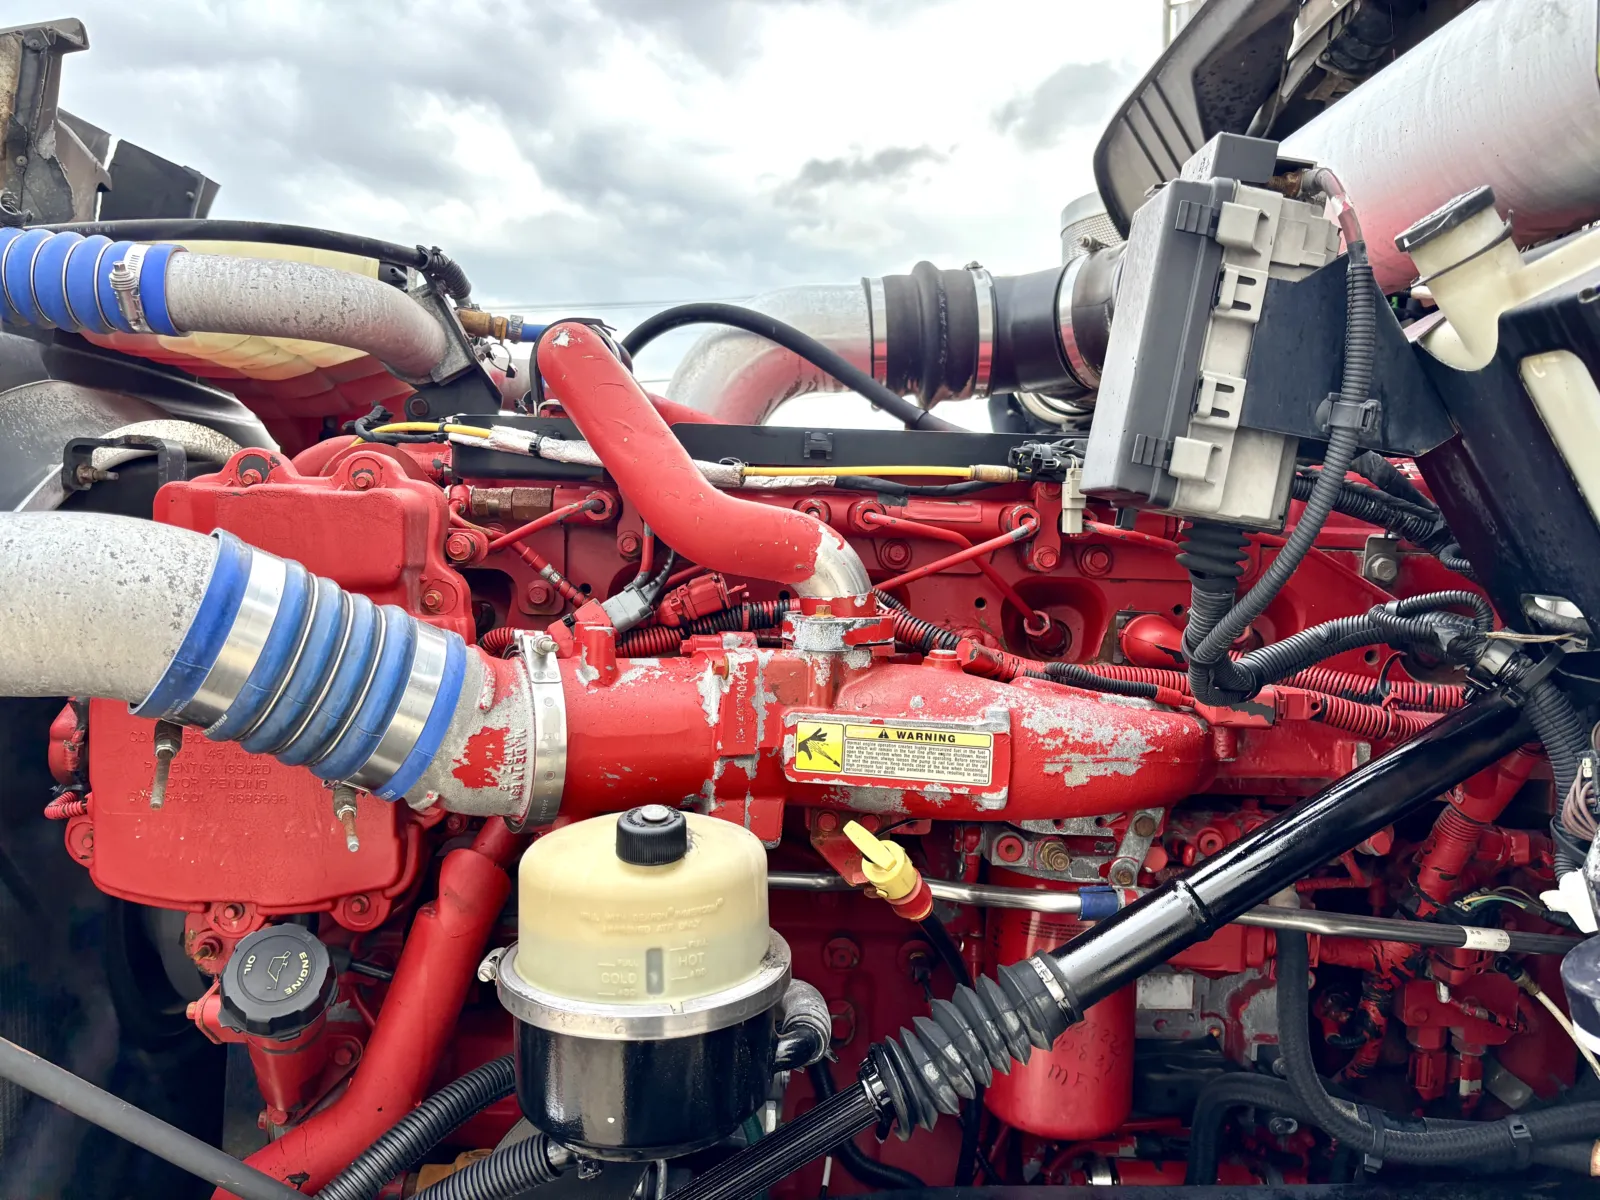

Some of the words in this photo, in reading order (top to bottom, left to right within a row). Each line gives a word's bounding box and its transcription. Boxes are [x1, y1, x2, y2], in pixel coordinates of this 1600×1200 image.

[129, 731, 154, 743] COV
[896, 731, 956, 743] WARNING
[512, 729, 527, 764] MADE
[225, 763, 272, 775] ISSUED
[209, 778, 268, 789] PENDING
[509, 784, 526, 801] USA
[688, 938, 709, 948] FULL
[244, 954, 257, 975] OIL
[617, 958, 638, 967] FULL
[678, 952, 705, 967] HOT
[284, 951, 310, 995] ENGINE
[600, 972, 638, 984] COLD
